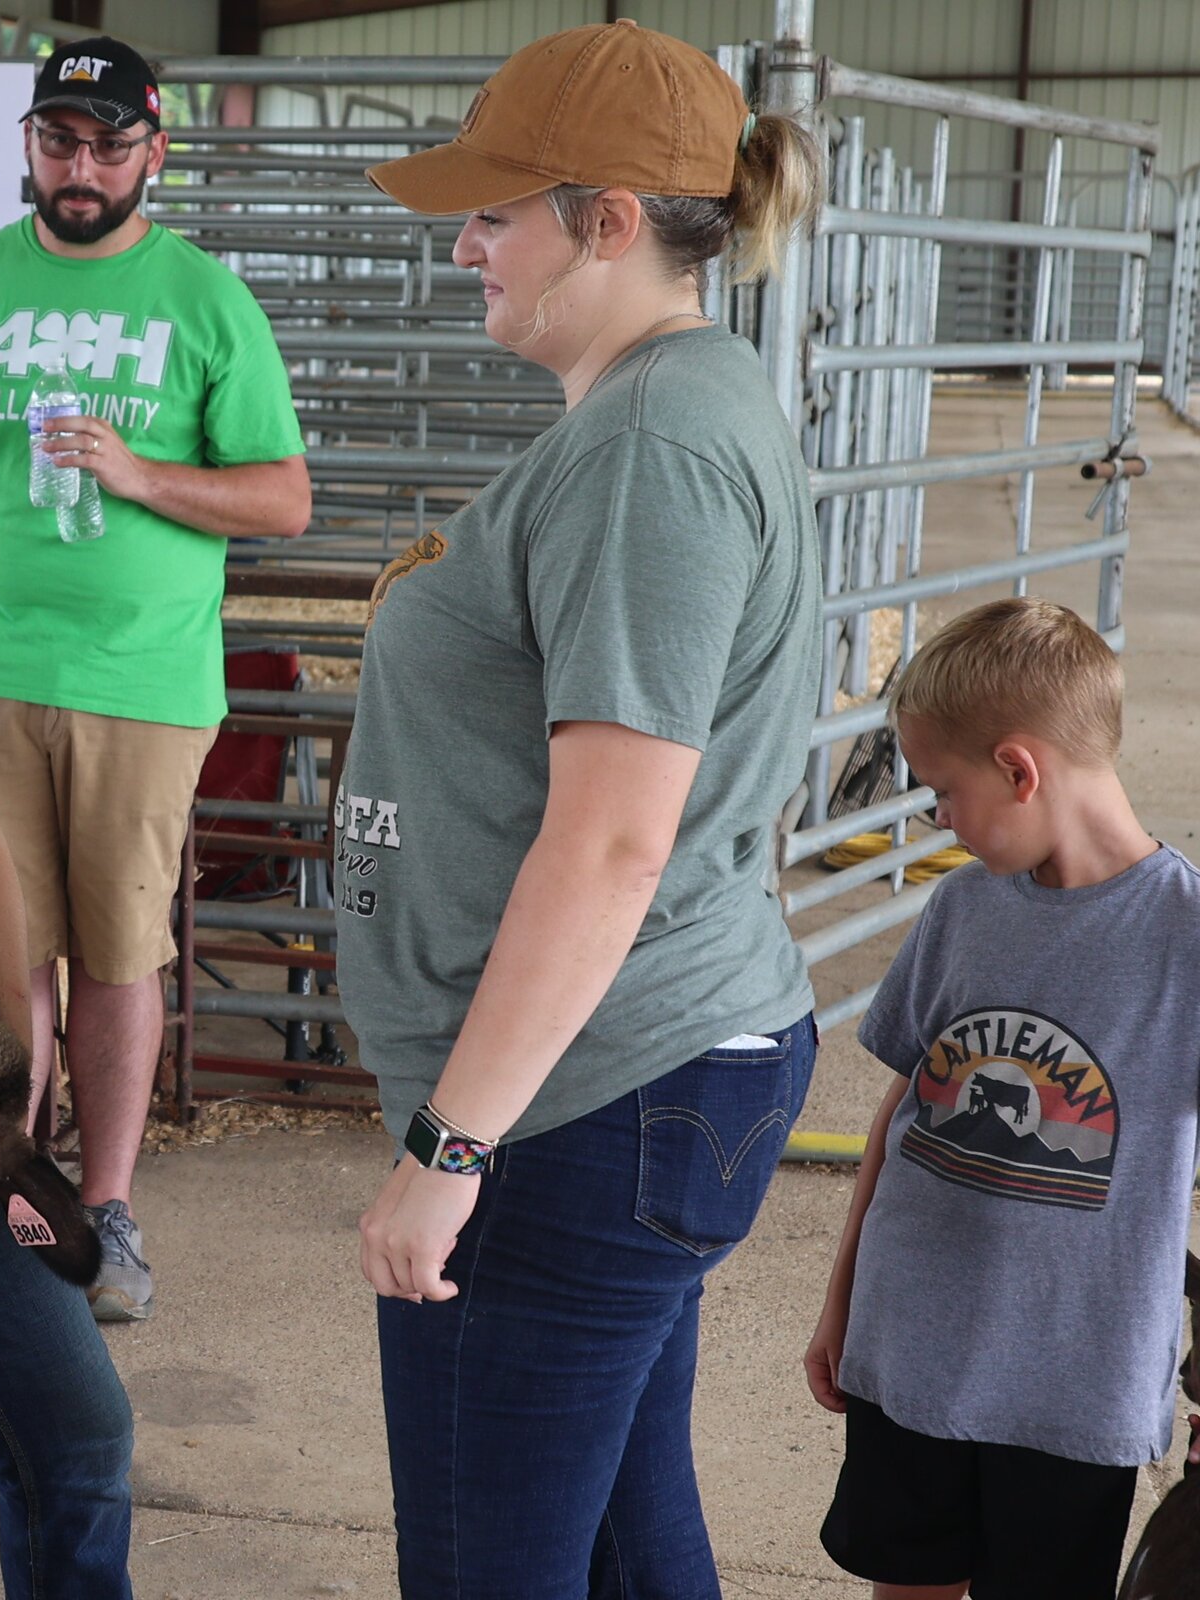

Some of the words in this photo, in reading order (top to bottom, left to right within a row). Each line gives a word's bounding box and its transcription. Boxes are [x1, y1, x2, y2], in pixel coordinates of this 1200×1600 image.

[59, 56, 107, 81] CAT
[924, 1018, 1115, 1124] CATTLEMAN
[11, 1223, 51, 1244] 3840
